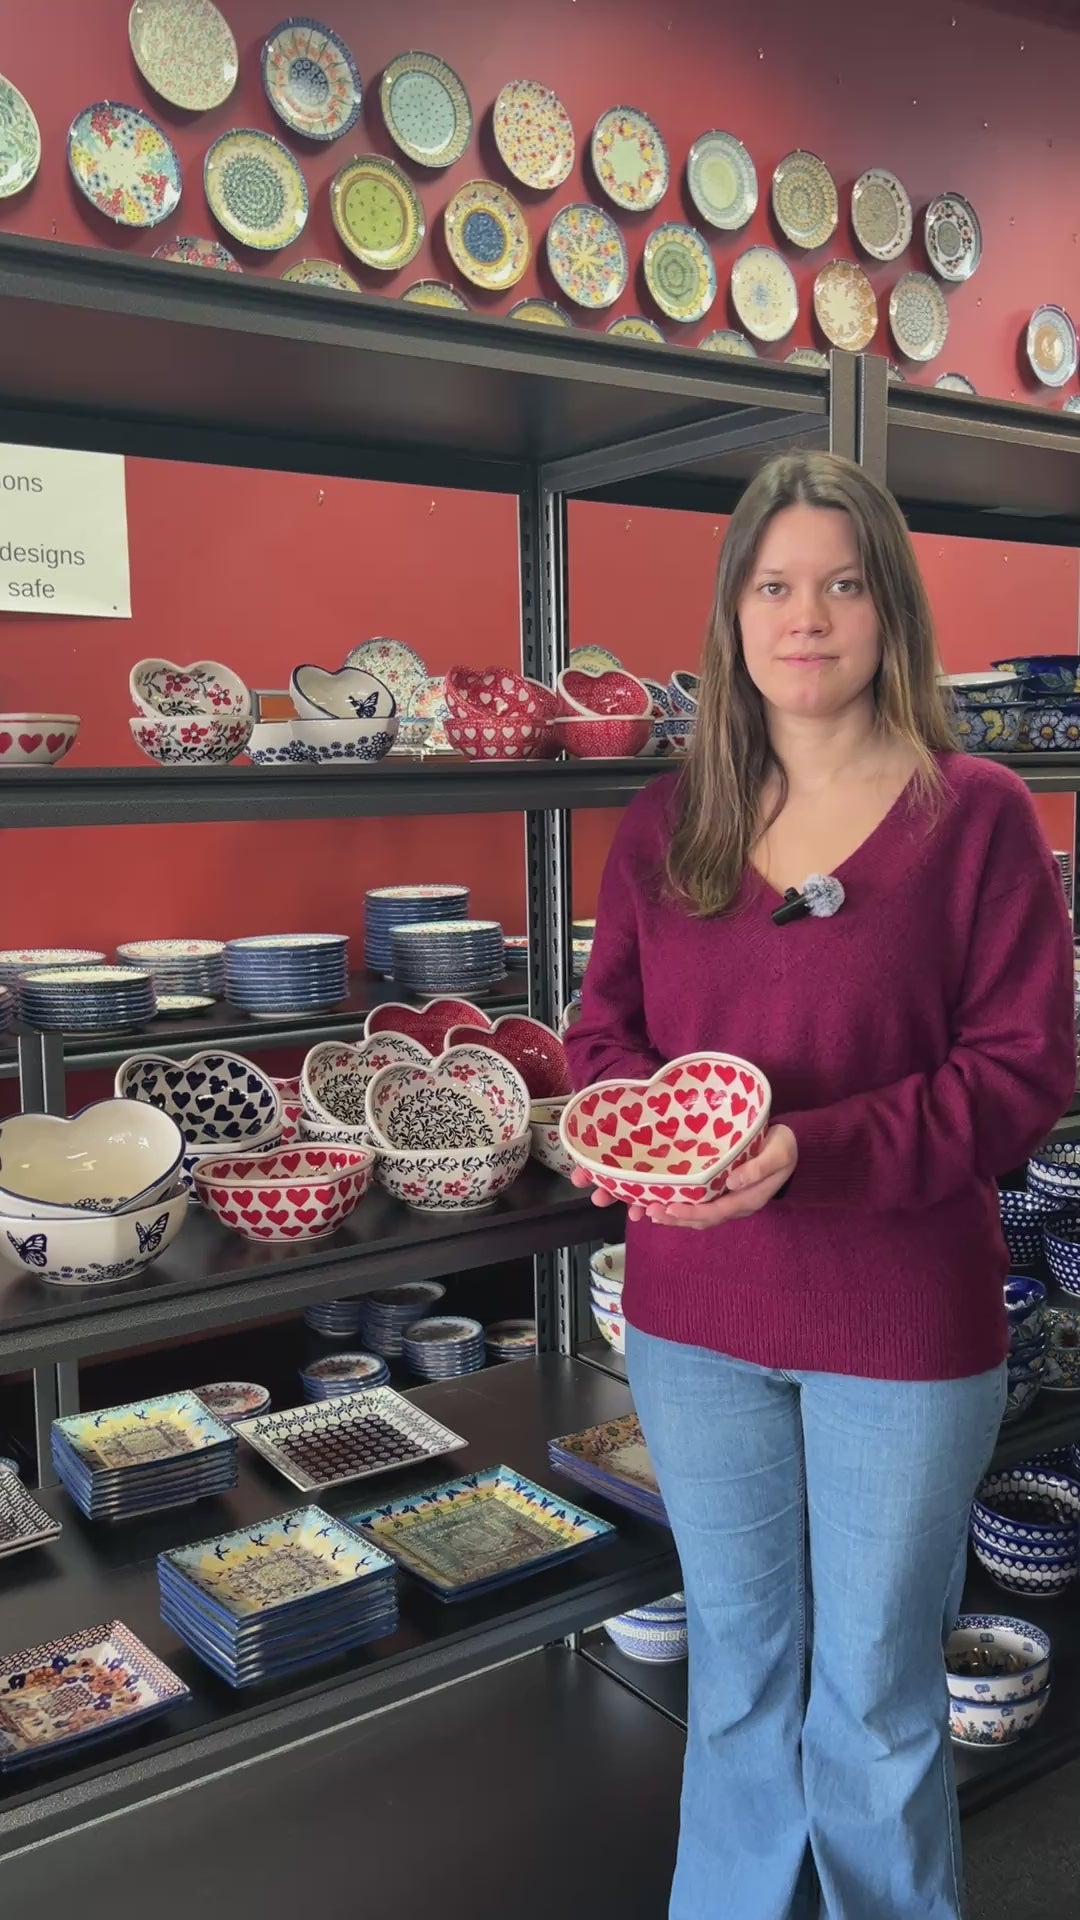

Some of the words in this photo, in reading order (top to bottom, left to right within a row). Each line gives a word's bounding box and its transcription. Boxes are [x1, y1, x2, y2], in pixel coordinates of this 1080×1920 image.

[0, 475, 43, 493] ons
[0, 541, 86, 569] designs
[8, 578, 55, 598] safe
